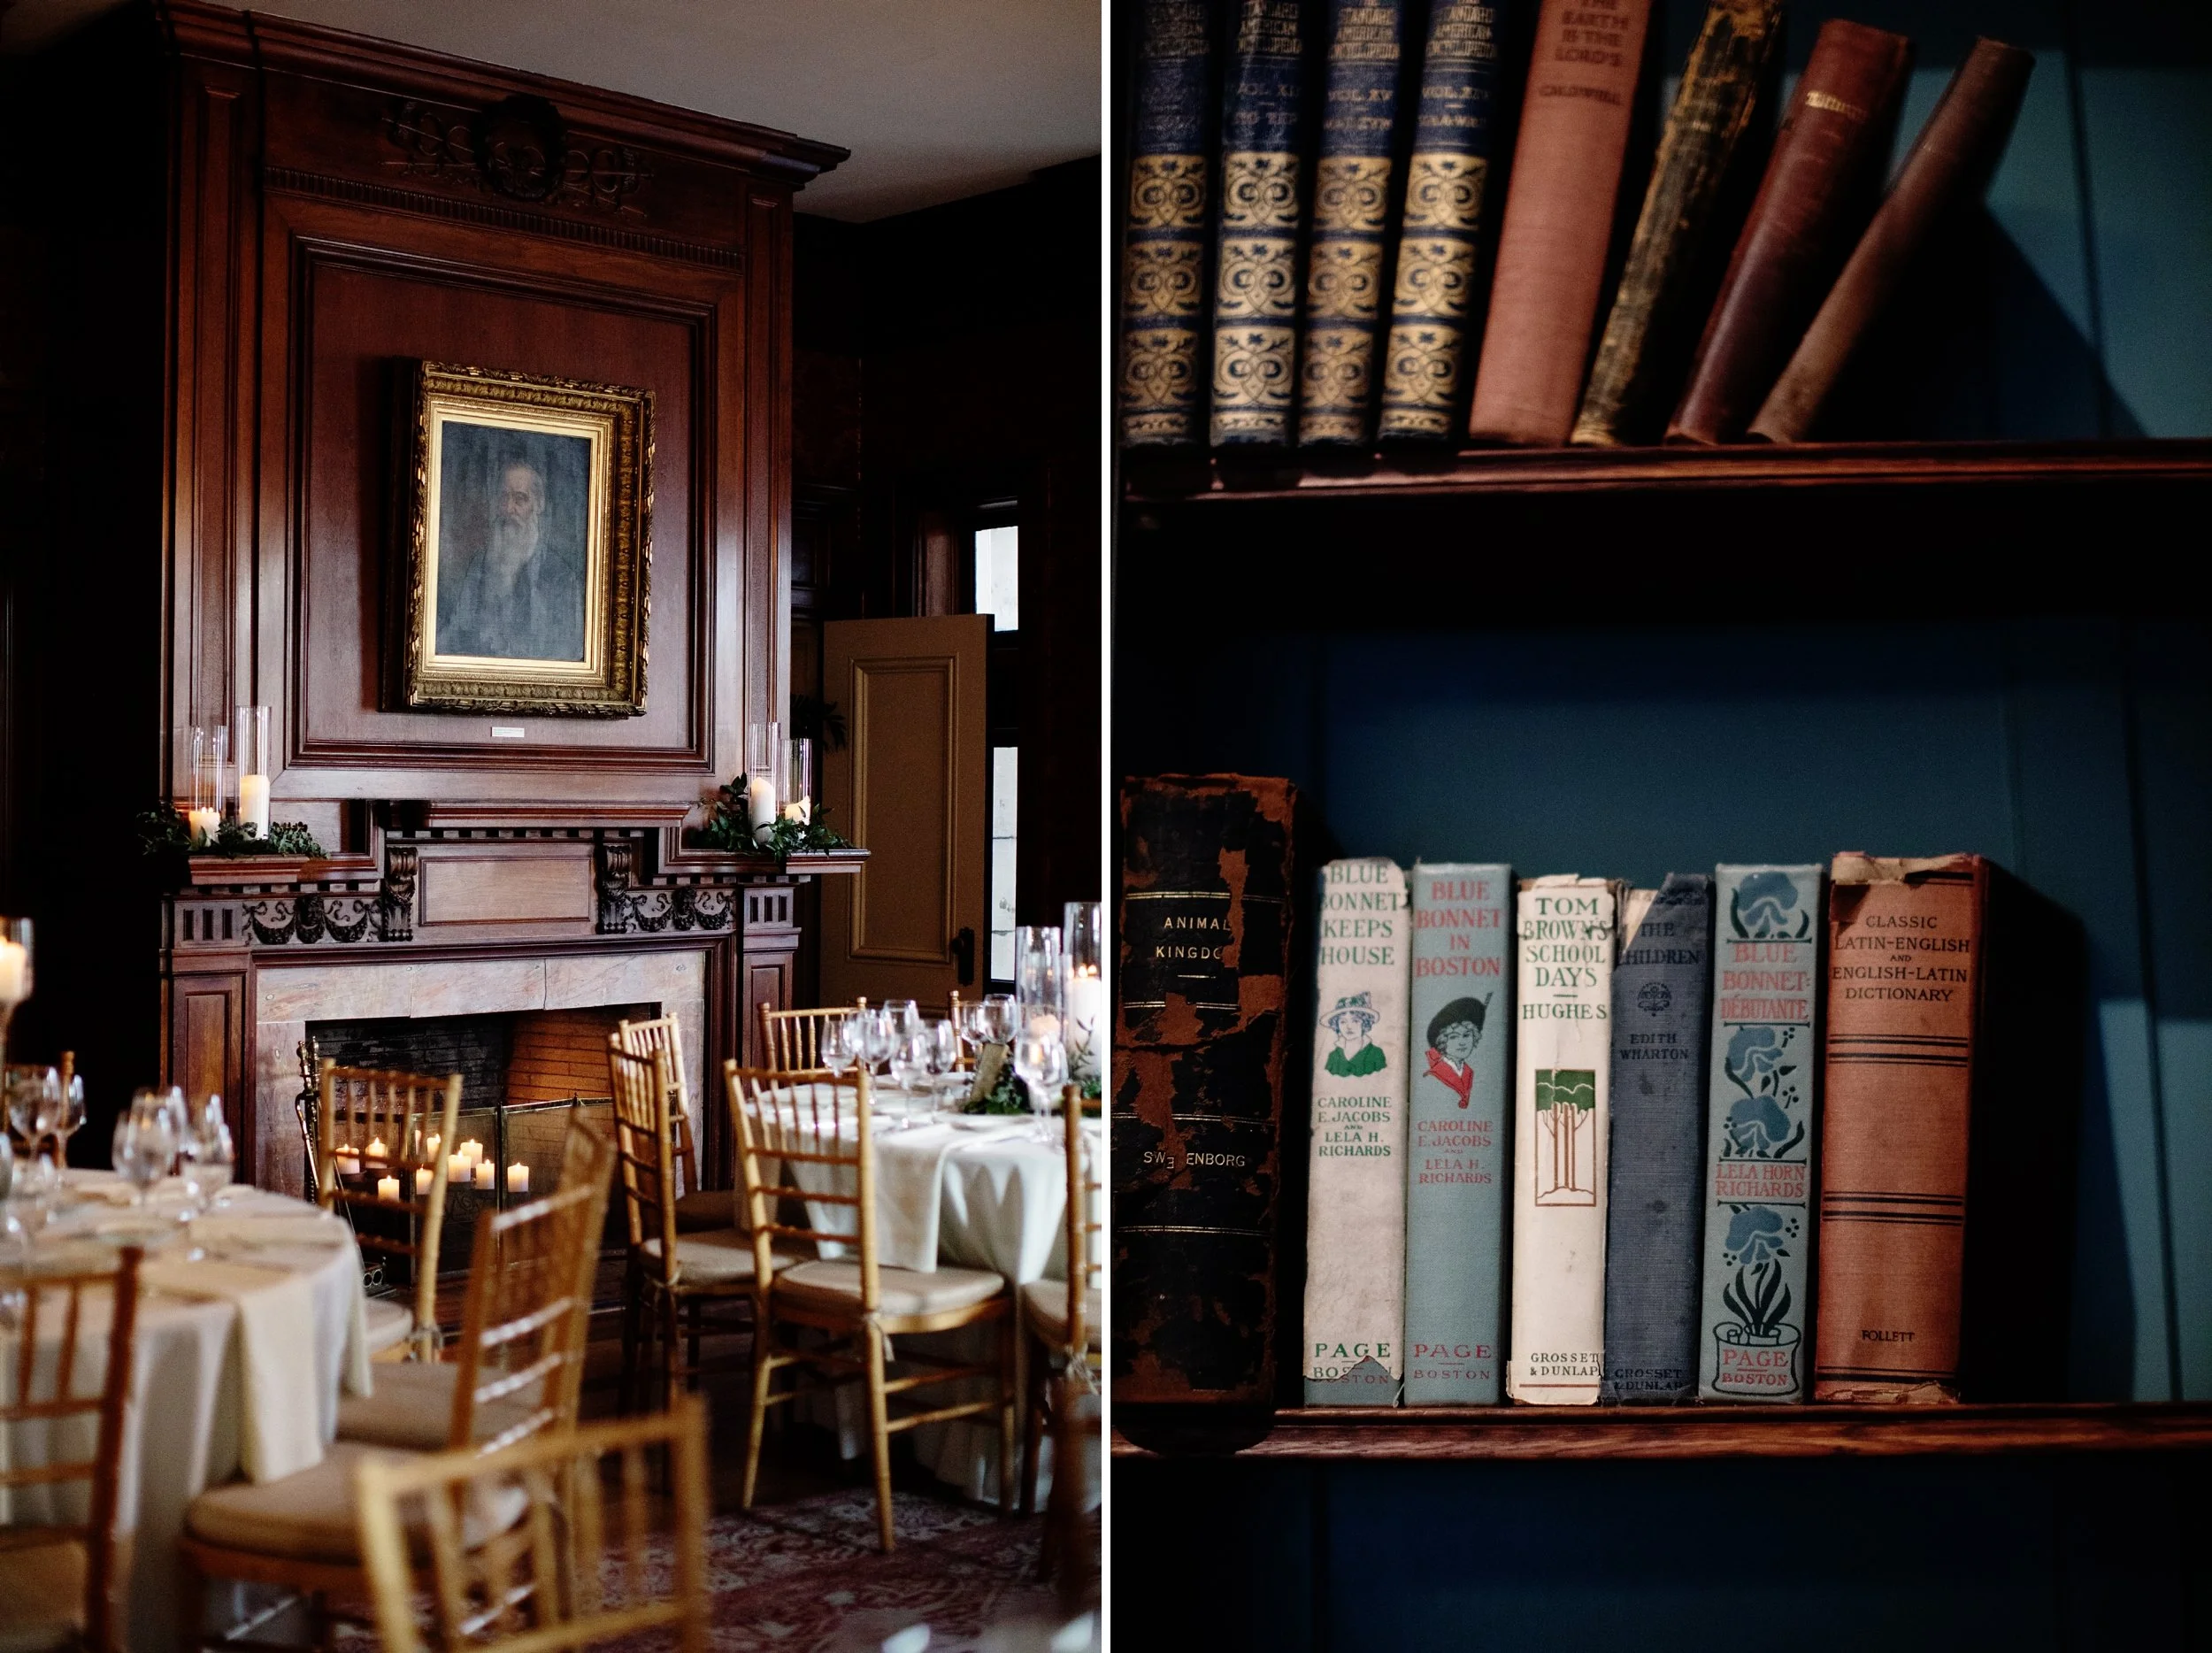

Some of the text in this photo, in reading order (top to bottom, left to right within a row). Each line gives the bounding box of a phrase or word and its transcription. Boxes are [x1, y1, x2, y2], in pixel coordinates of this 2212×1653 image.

[1331, 864, 1388, 884] BLUE
[1432, 880, 1490, 900] BLUE
[1324, 892, 1401, 911] ONNET
[1535, 897, 1599, 915] TOM
[1417, 909, 1500, 928] BONNET
[1866, 916, 1938, 929] CLASSIC
[1323, 919, 1393, 938] KEEPS
[1641, 923, 1674, 937] THE
[1450, 934, 1470, 950] IN
[1834, 935, 1970, 953] LATIN-ENGLISH
[1320, 947, 1395, 965] HOUSE
[1525, 945, 1605, 963] SCHOOL
[1734, 943, 1798, 964] BLUE
[1416, 957, 1501, 977] BOSTON
[1832, 966, 1968, 983] ENGLISH-LATIN
[1535, 967, 1598, 987] DAYS
[1846, 988, 1955, 1001] DICTIONARY
[1523, 1004, 1608, 1019] HUGHES
[1631, 1034, 1677, 1044] EDITH
[1619, 1049, 1689, 1060] WHARTON
[1317, 1096, 1393, 1109] CAROLINE
[1417, 1120, 1494, 1132] CAROLINE
[1325, 1132, 1384, 1142] LELA H.
[1318, 1145, 1391, 1157] RICHARDS
[1425, 1159, 1463, 1170] LELA
[1717, 1164, 1806, 1180] LELA HORN
[1418, 1172, 1492, 1184] RICHARDS
[1716, 1180, 1805, 1198] RICHARDS
[1862, 1330, 1915, 1342] FOLLETT
[1315, 1343, 1390, 1357] PAGE
[1414, 1344, 1492, 1358] PAGE
[1531, 1353, 1599, 1363] GROSSET
[1722, 1349, 1789, 1367] PAGE
[1413, 1370, 1490, 1380] BOSTON
[1530, 1366, 1600, 1376] & DUNLAP
[1615, 1369, 1682, 1379] GROSSET
[1721, 1372, 1788, 1387] BOSTON
